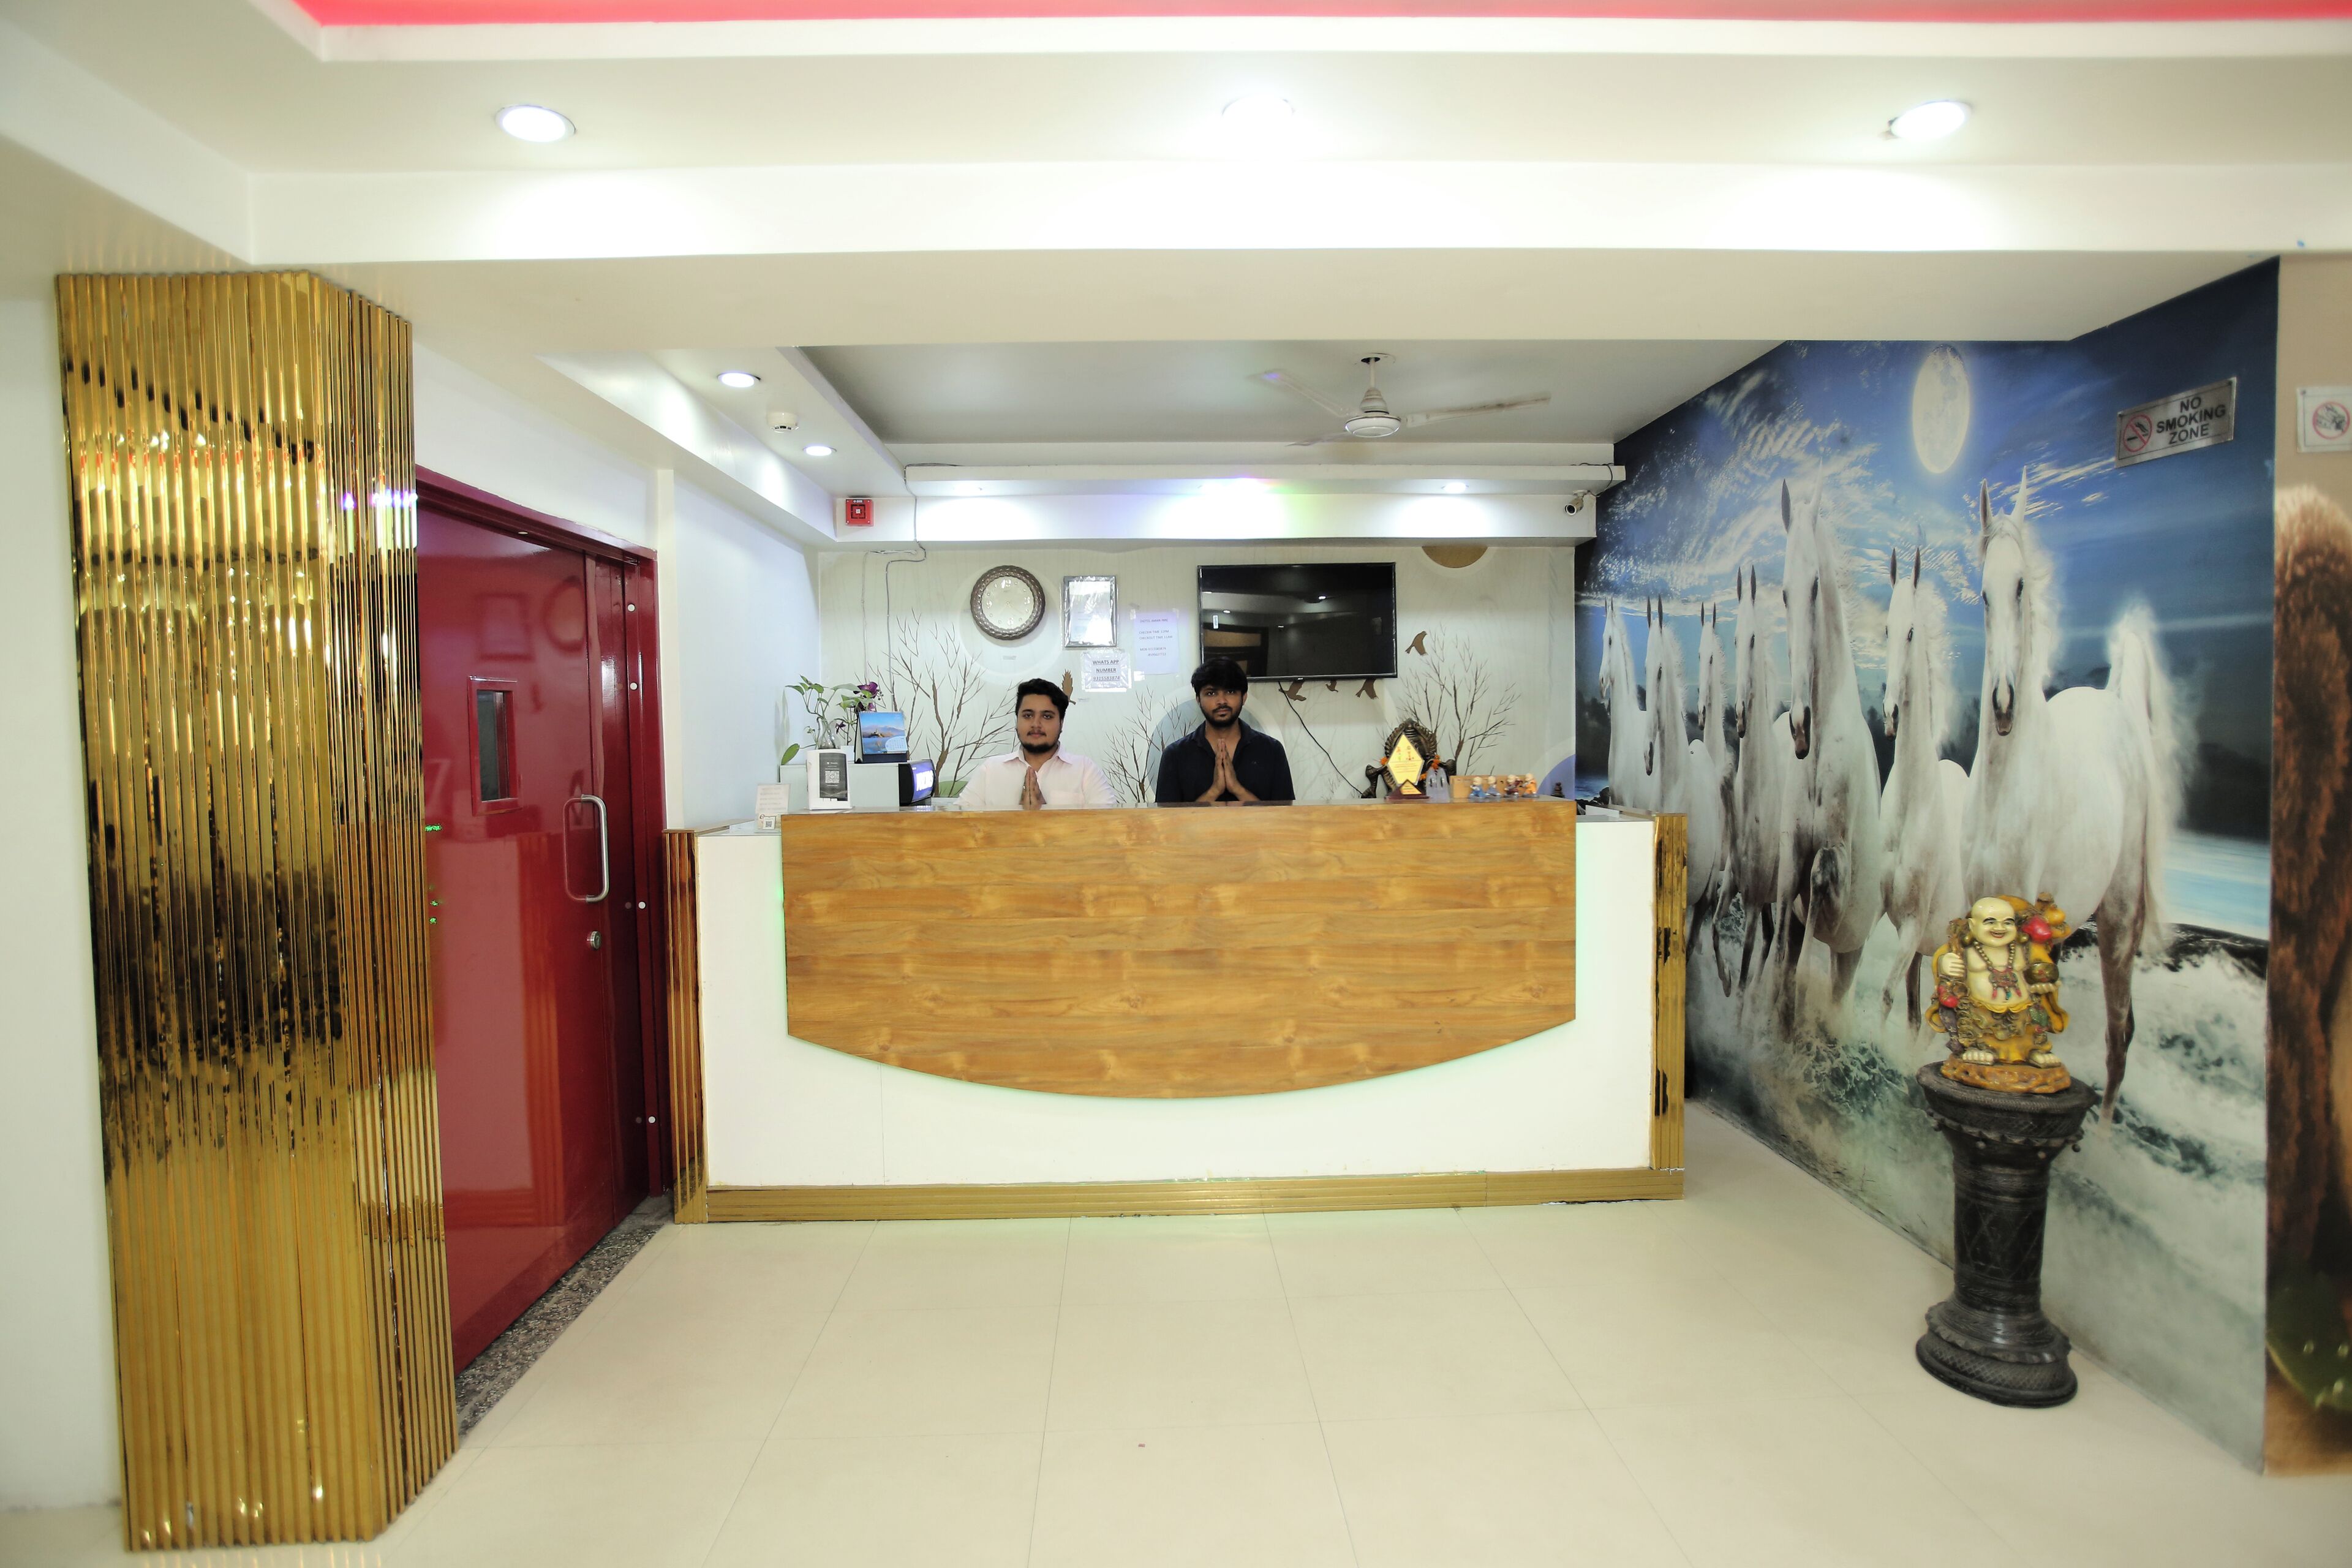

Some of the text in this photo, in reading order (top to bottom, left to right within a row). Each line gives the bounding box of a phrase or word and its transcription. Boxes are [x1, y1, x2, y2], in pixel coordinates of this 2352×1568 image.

[2180, 396, 2202, 413] NO
[2157, 404, 2226, 434] SMOKING
[2169, 423, 2210, 445] ZONE
